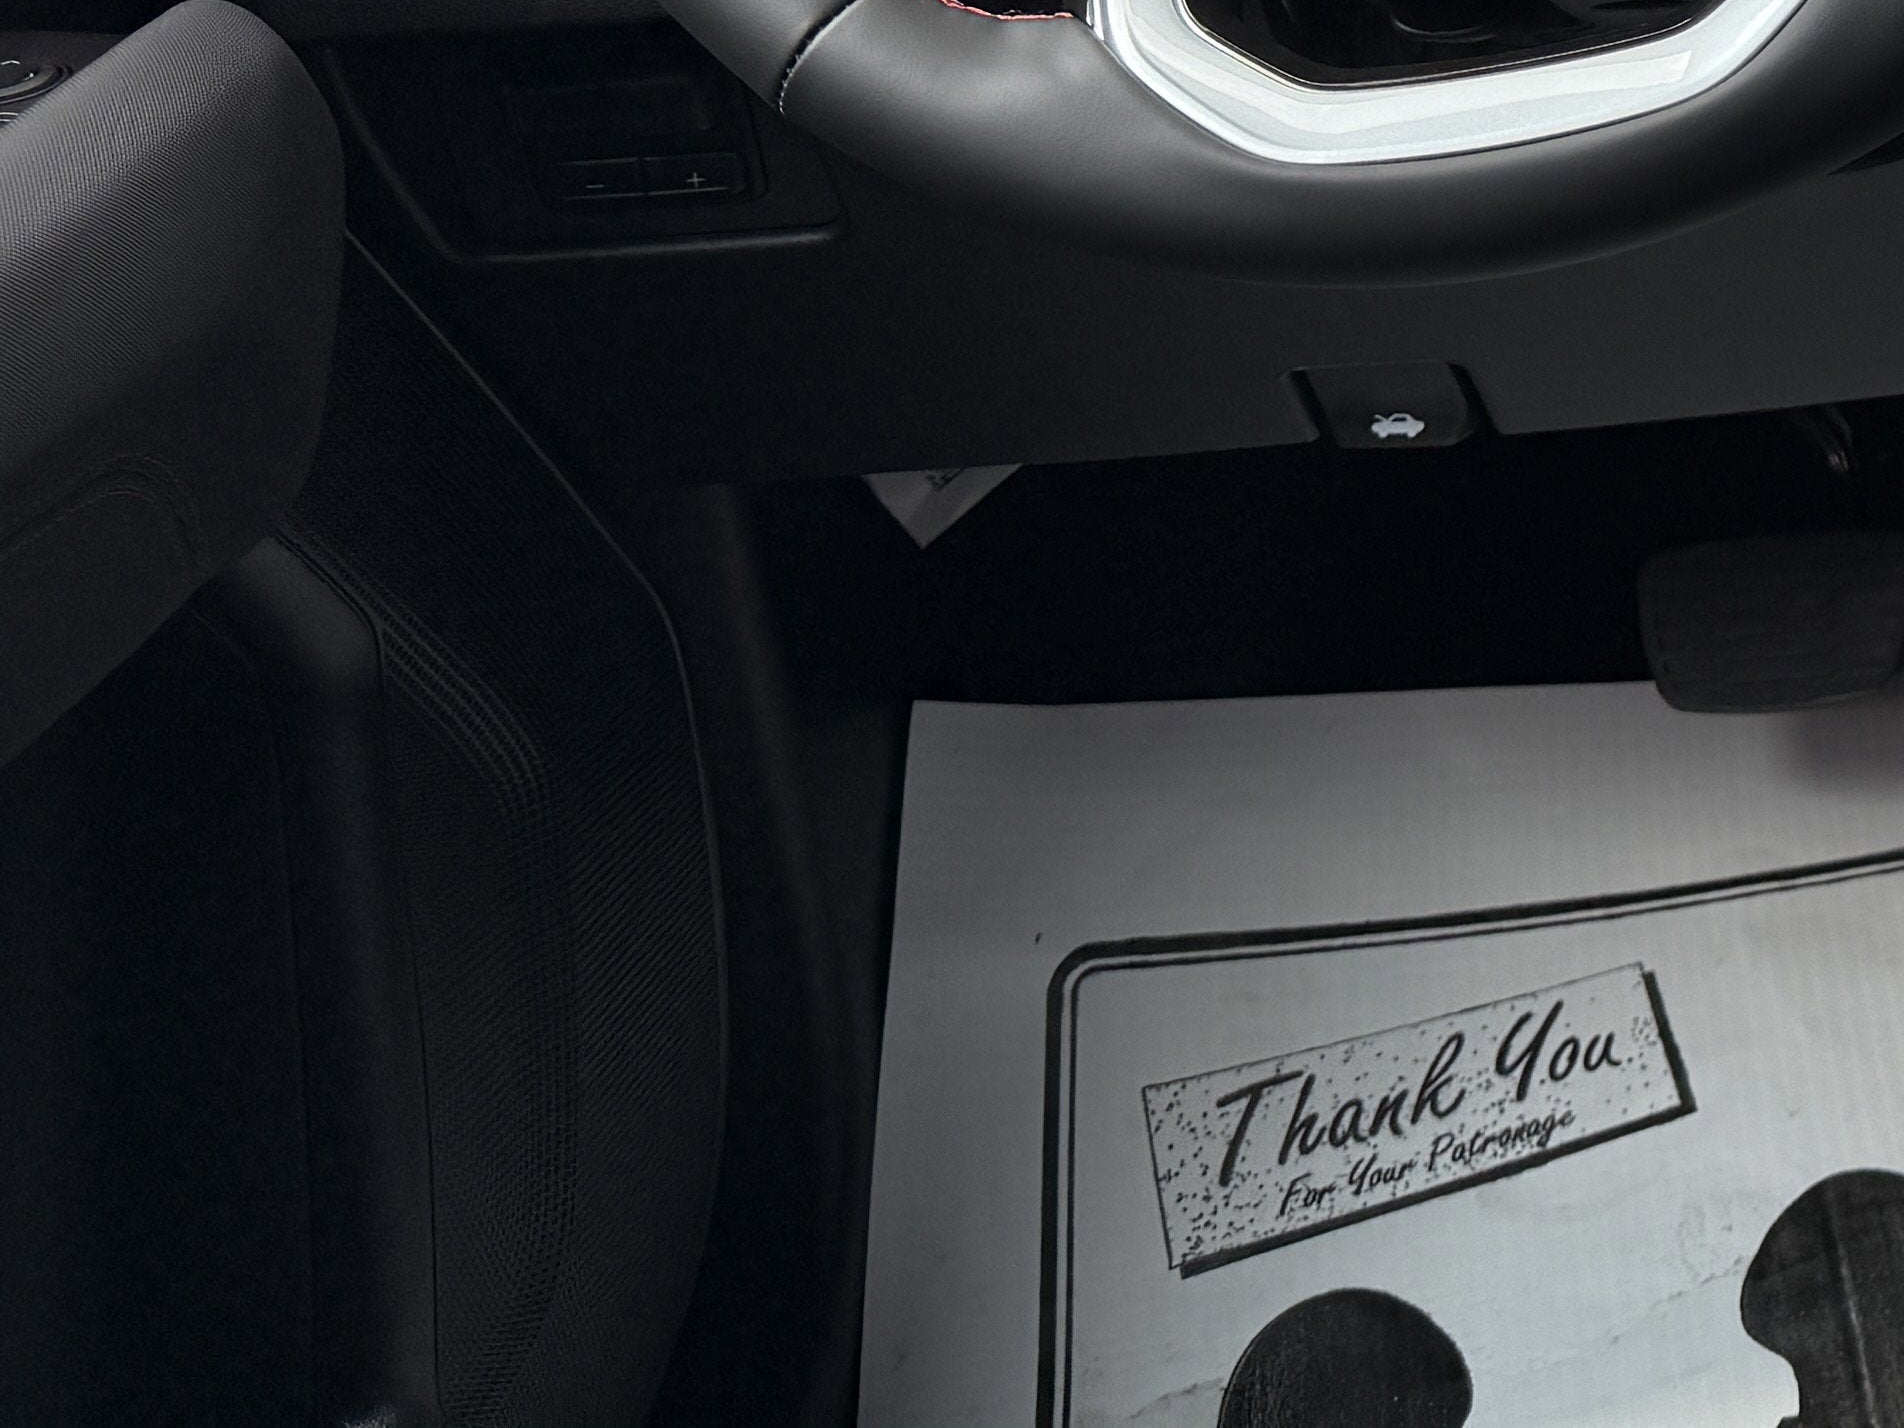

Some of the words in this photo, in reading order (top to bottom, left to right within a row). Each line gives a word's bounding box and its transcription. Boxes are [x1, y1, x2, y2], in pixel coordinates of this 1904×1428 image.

[1216, 1031, 1466, 1187] Thank
[1495, 999, 1620, 1102] You
[1279, 1173, 1337, 1218] For
[1347, 1151, 1418, 1197] Your
[1428, 1108, 1577, 1172] Patronage
